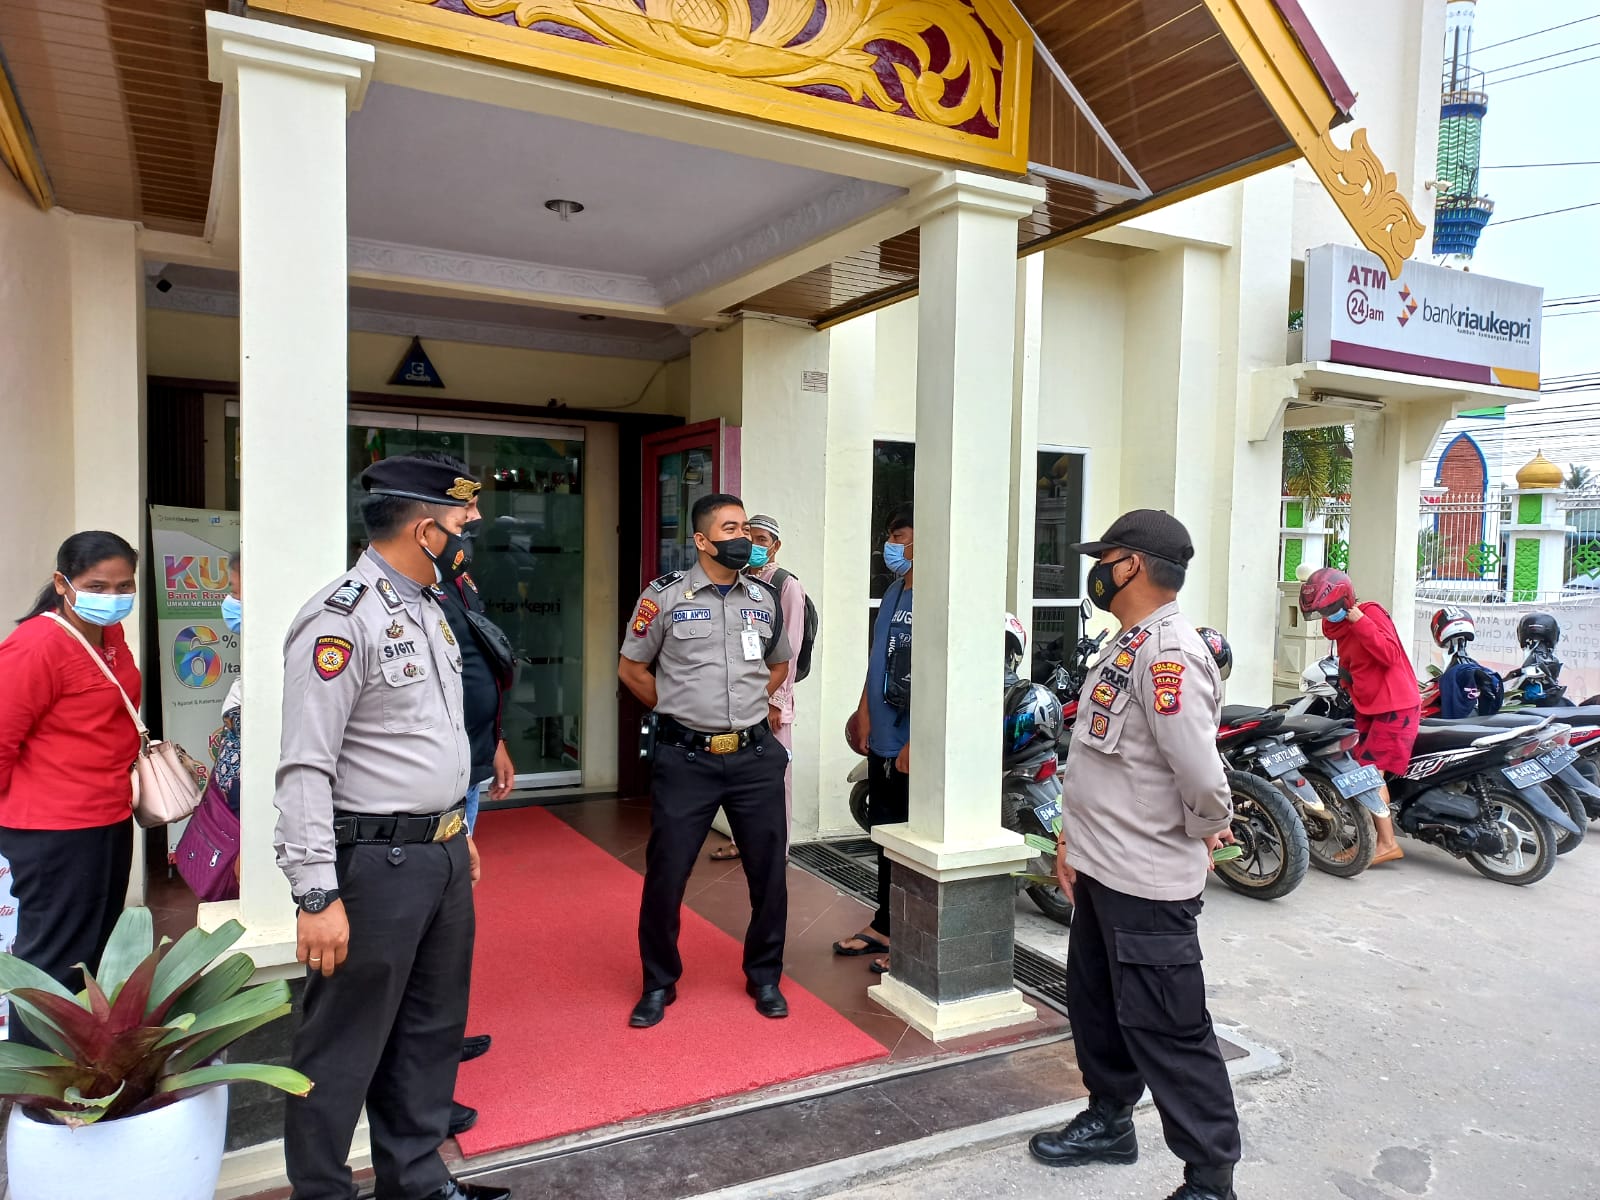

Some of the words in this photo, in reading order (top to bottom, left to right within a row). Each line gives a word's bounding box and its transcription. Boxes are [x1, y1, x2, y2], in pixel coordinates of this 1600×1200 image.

[1347, 265, 1386, 290] ATM
[1351, 297, 1365, 317] 24
[1422, 297, 1531, 342] bankriaukepri
[163, 555, 230, 590] KU
[167, 591, 197, 600] Bank
[173, 626, 222, 689] 6
[222, 635, 237, 649] %
[383, 641, 416, 658] SIGIT
[224, 662, 240, 674] /ta
[1100, 666, 1130, 690] POLRI
